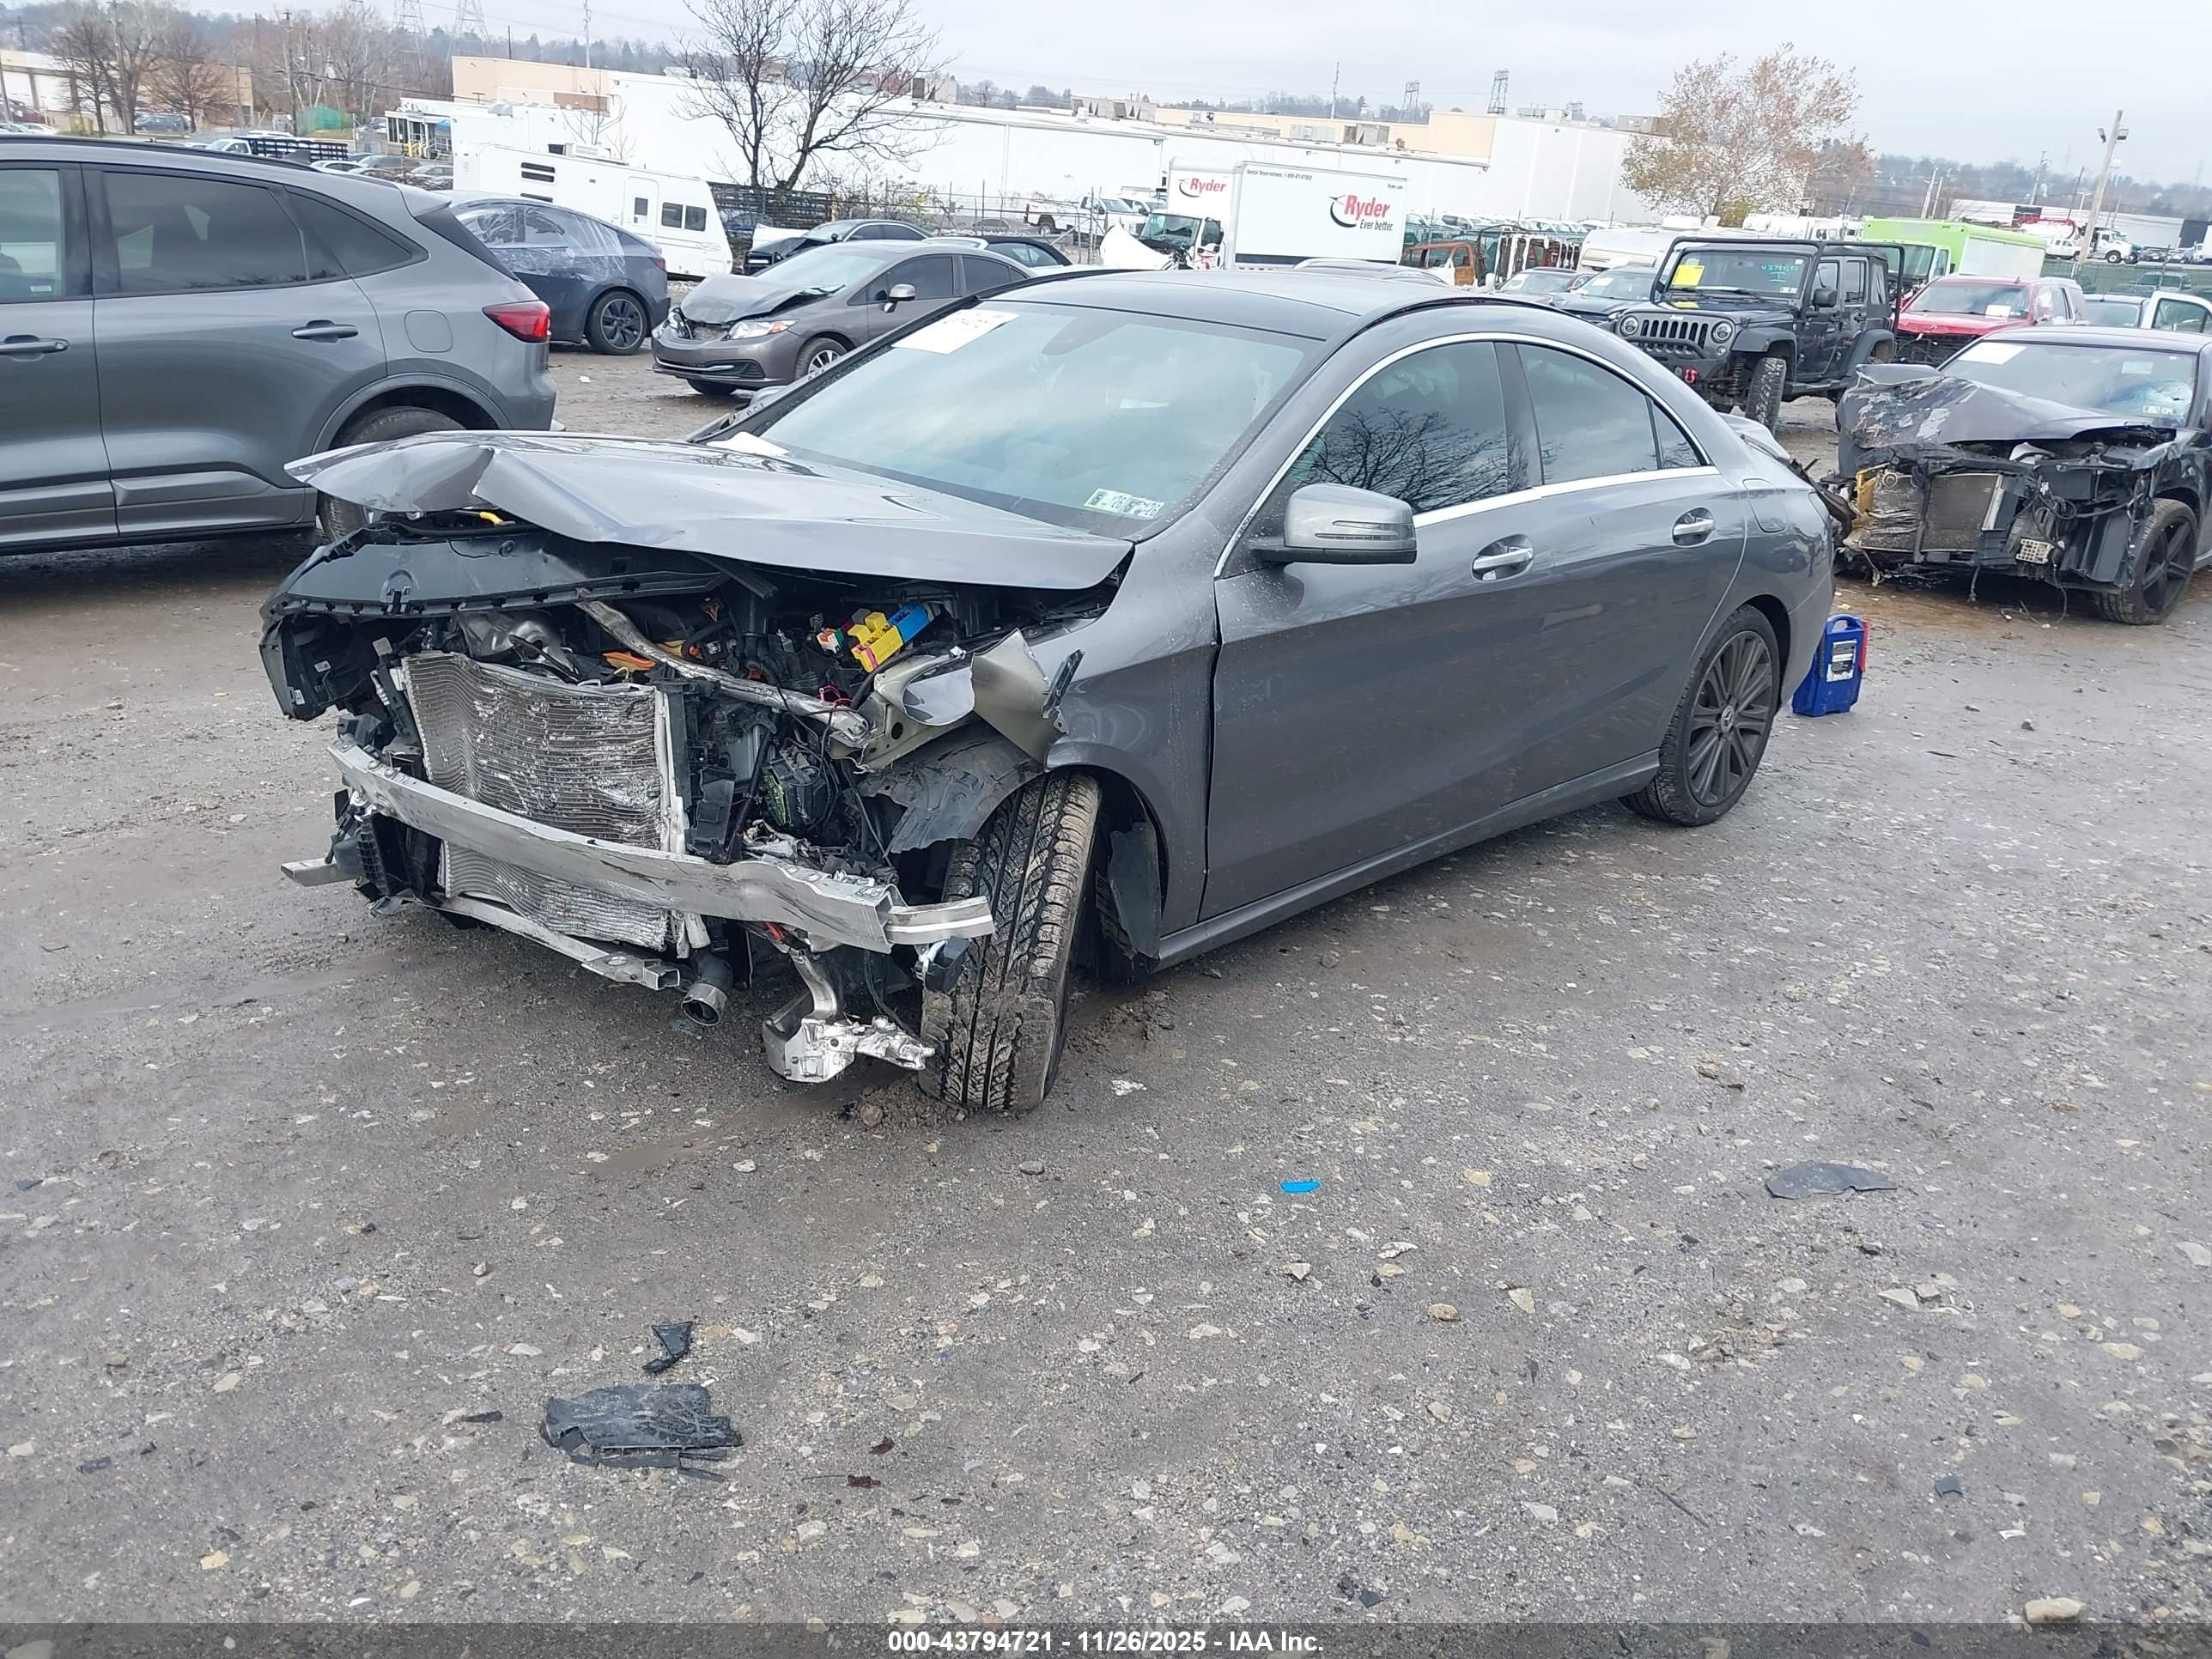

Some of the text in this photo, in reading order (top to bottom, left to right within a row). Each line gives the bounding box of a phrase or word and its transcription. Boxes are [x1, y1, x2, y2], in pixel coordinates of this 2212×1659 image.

[1190, 178, 1226, 193] Ryder
[1344, 195, 1390, 221] Ryder
[1359, 218, 1394, 231] Ever better.
